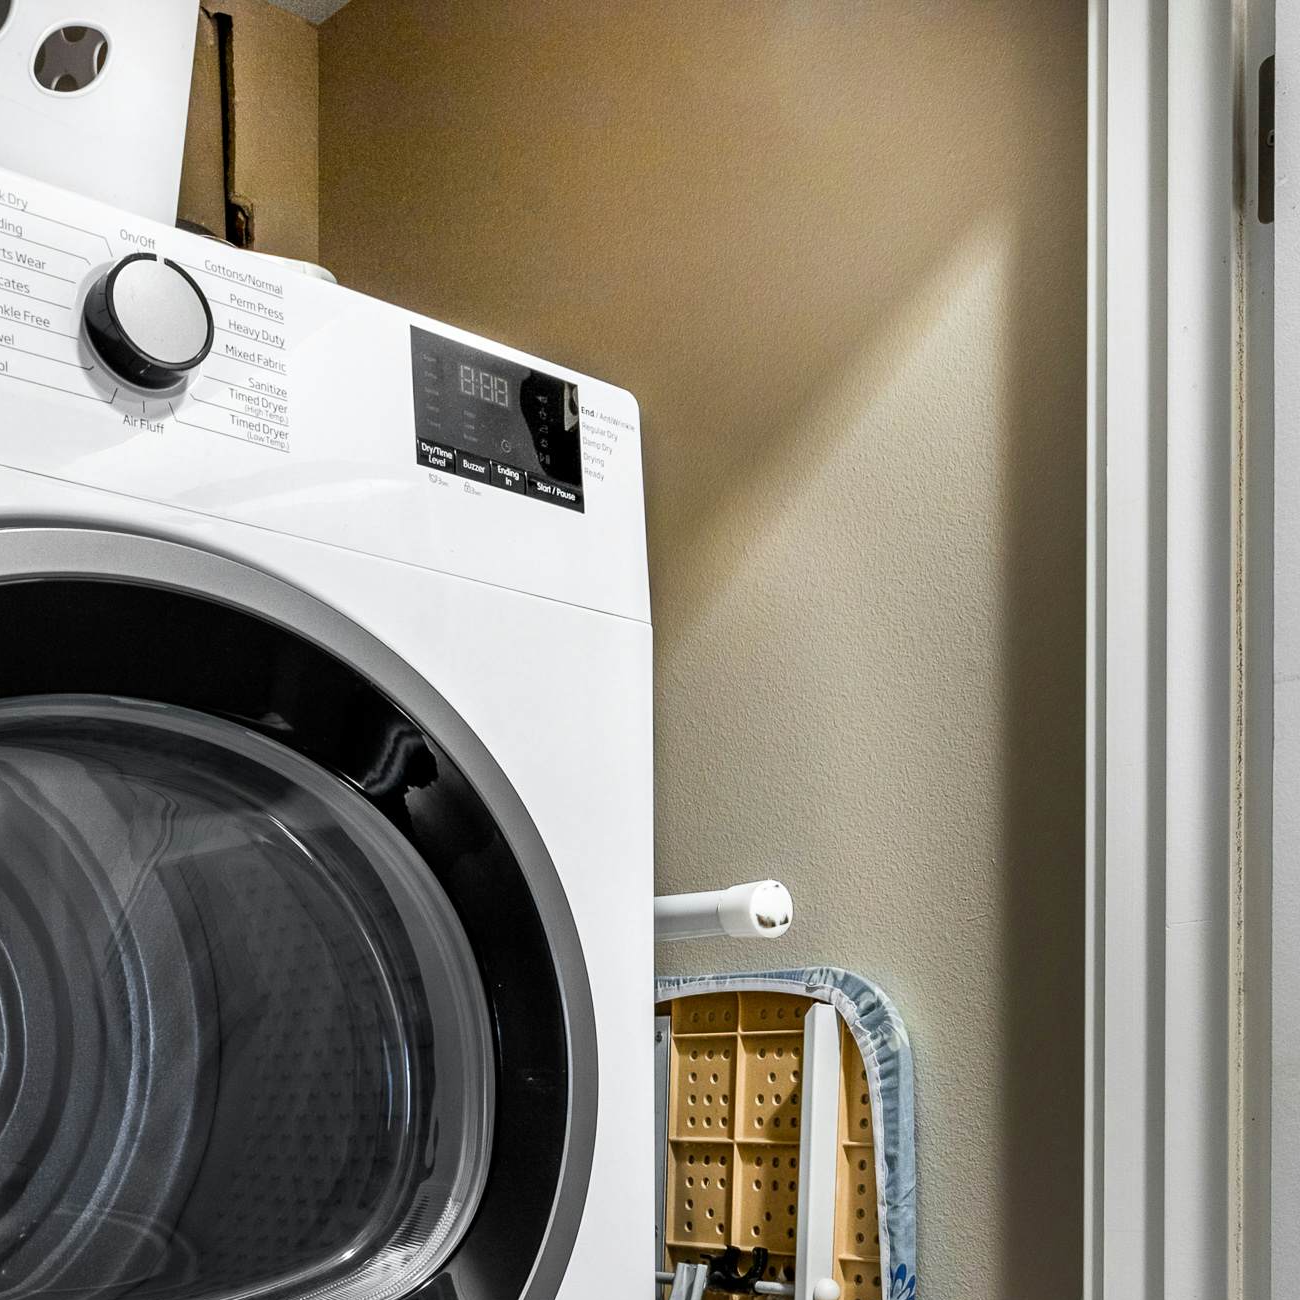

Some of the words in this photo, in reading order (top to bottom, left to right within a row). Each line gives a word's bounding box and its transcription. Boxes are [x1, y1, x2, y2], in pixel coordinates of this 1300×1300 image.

[8, 192, 28, 211] Dry
[120, 229, 156, 250] On/Off
[16, 252, 46, 270] Wear
[204, 260, 283, 295] Cottons/Normal
[230, 294, 255, 311] Perm
[257, 302, 284, 321] Press
[22, 309, 51, 328] Free
[228, 319, 260, 341] Heavy
[261, 329, 285, 347] Duty
[226, 344, 255, 362] Mixed
[256, 353, 287, 372] Fabric
[248, 377, 287, 397] Sanitize
[228, 388, 254, 406] Timed
[256, 396, 288, 415] Dryer
[244, 405, 264, 418] (High
[266, 410, 289, 424] Temp.)
[581, 406, 594, 417] End
[123, 414, 139, 428] Air
[140, 417, 164, 434] Fluff
[230, 414, 255, 432] Timed
[257, 422, 289, 441] Dryer
[582, 423, 601, 438] Regular
[603, 431, 618, 443] Dry
[246, 430, 264, 442] (Low
[266, 436, 290, 450] Temp.)
[582, 437, 599, 451] Damp
[600, 443, 613, 455] Dry
[421, 442, 452, 460] Dry/Time
[428, 453, 446, 467] Level
[583, 453, 605, 467] Drying
[463, 459, 485, 474] Buzzer
[497, 465, 519, 480] Ending
[584, 467, 605, 481] Ready
[505, 477, 512, 487] In
[537, 481, 552, 494] Start
[556, 487, 576, 502] Pause
